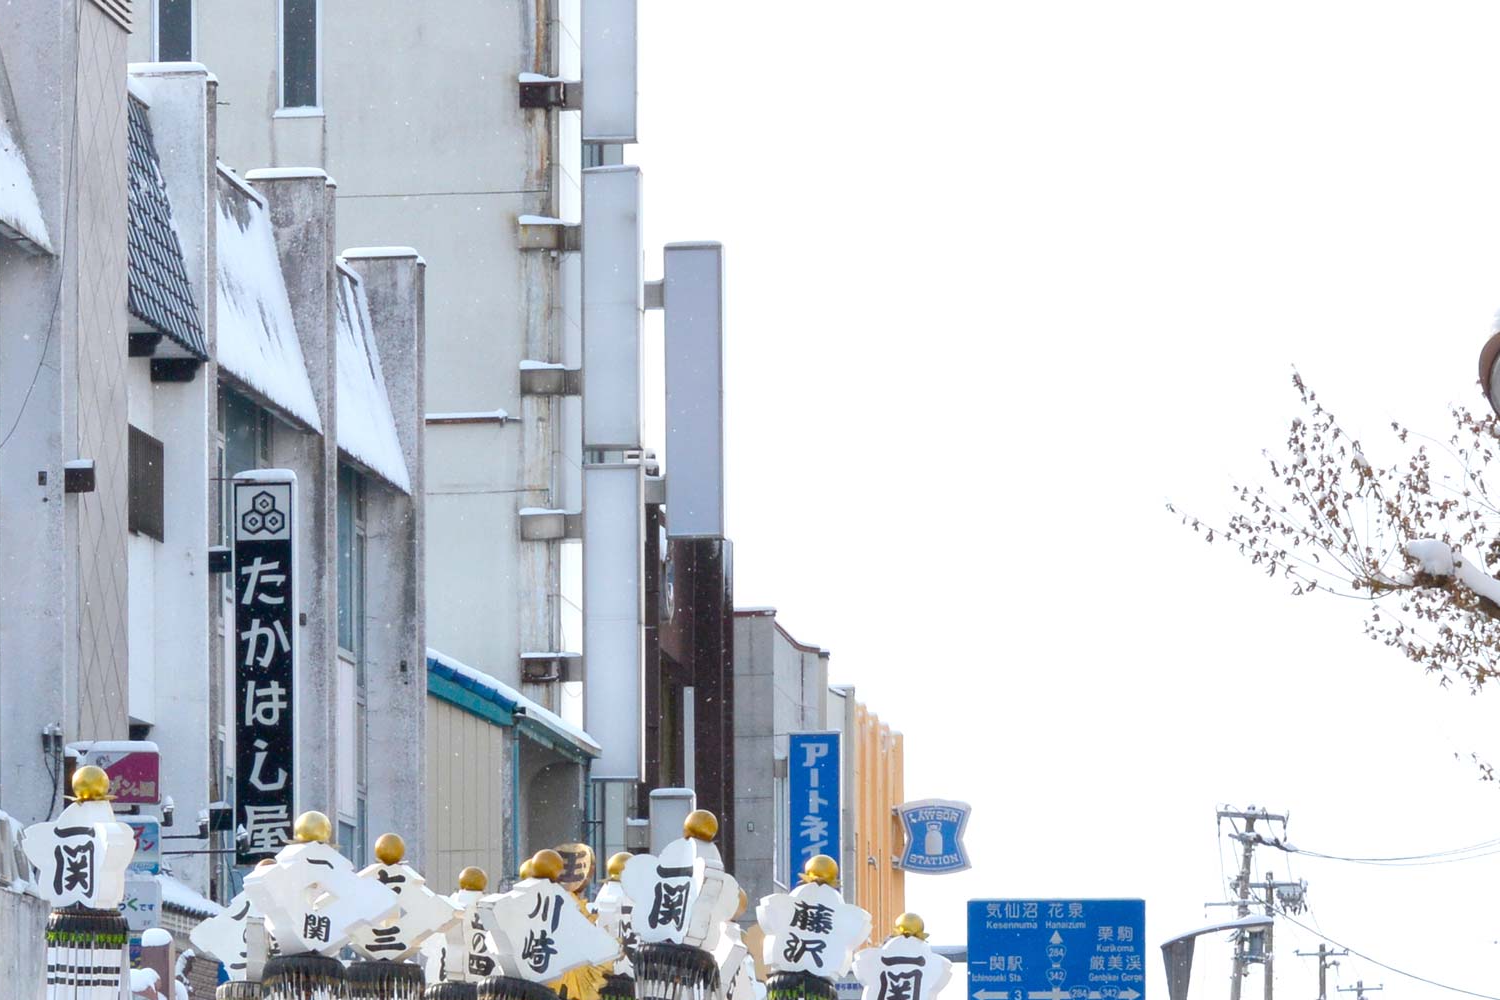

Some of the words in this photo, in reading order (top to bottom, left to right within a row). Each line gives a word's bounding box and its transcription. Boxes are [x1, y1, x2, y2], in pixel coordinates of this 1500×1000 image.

[241, 556, 291, 857] たかはし屋
[908, 810, 959, 823] LAWSON
[53, 826, 96, 898] 一関
[909, 853, 959, 865] STATION
[648, 864, 694, 931] 一関
[986, 902, 1038, 919] 気仙沼
[1048, 902, 1085, 919] 花泉
[986, 920, 1038, 930] Kesennuma
[1045, 920, 1087, 930] Hanaizumi
[521, 892, 565, 974] 川崎
[783, 900, 835, 968] 藤沢
[1097, 925, 1134, 942] 栗駒
[1047, 948, 1065, 958] 284
[1096, 943, 1134, 953] Kurikoma
[971, 955, 1024, 972] 一関駅
[971, 973, 1007, 983] Ichinoseki
[1047, 971, 1065, 981] 342
[1120, 973, 1143, 983] Gorge
[1071, 988, 1088, 998] 284
[1102, 988, 1119, 998] 342
